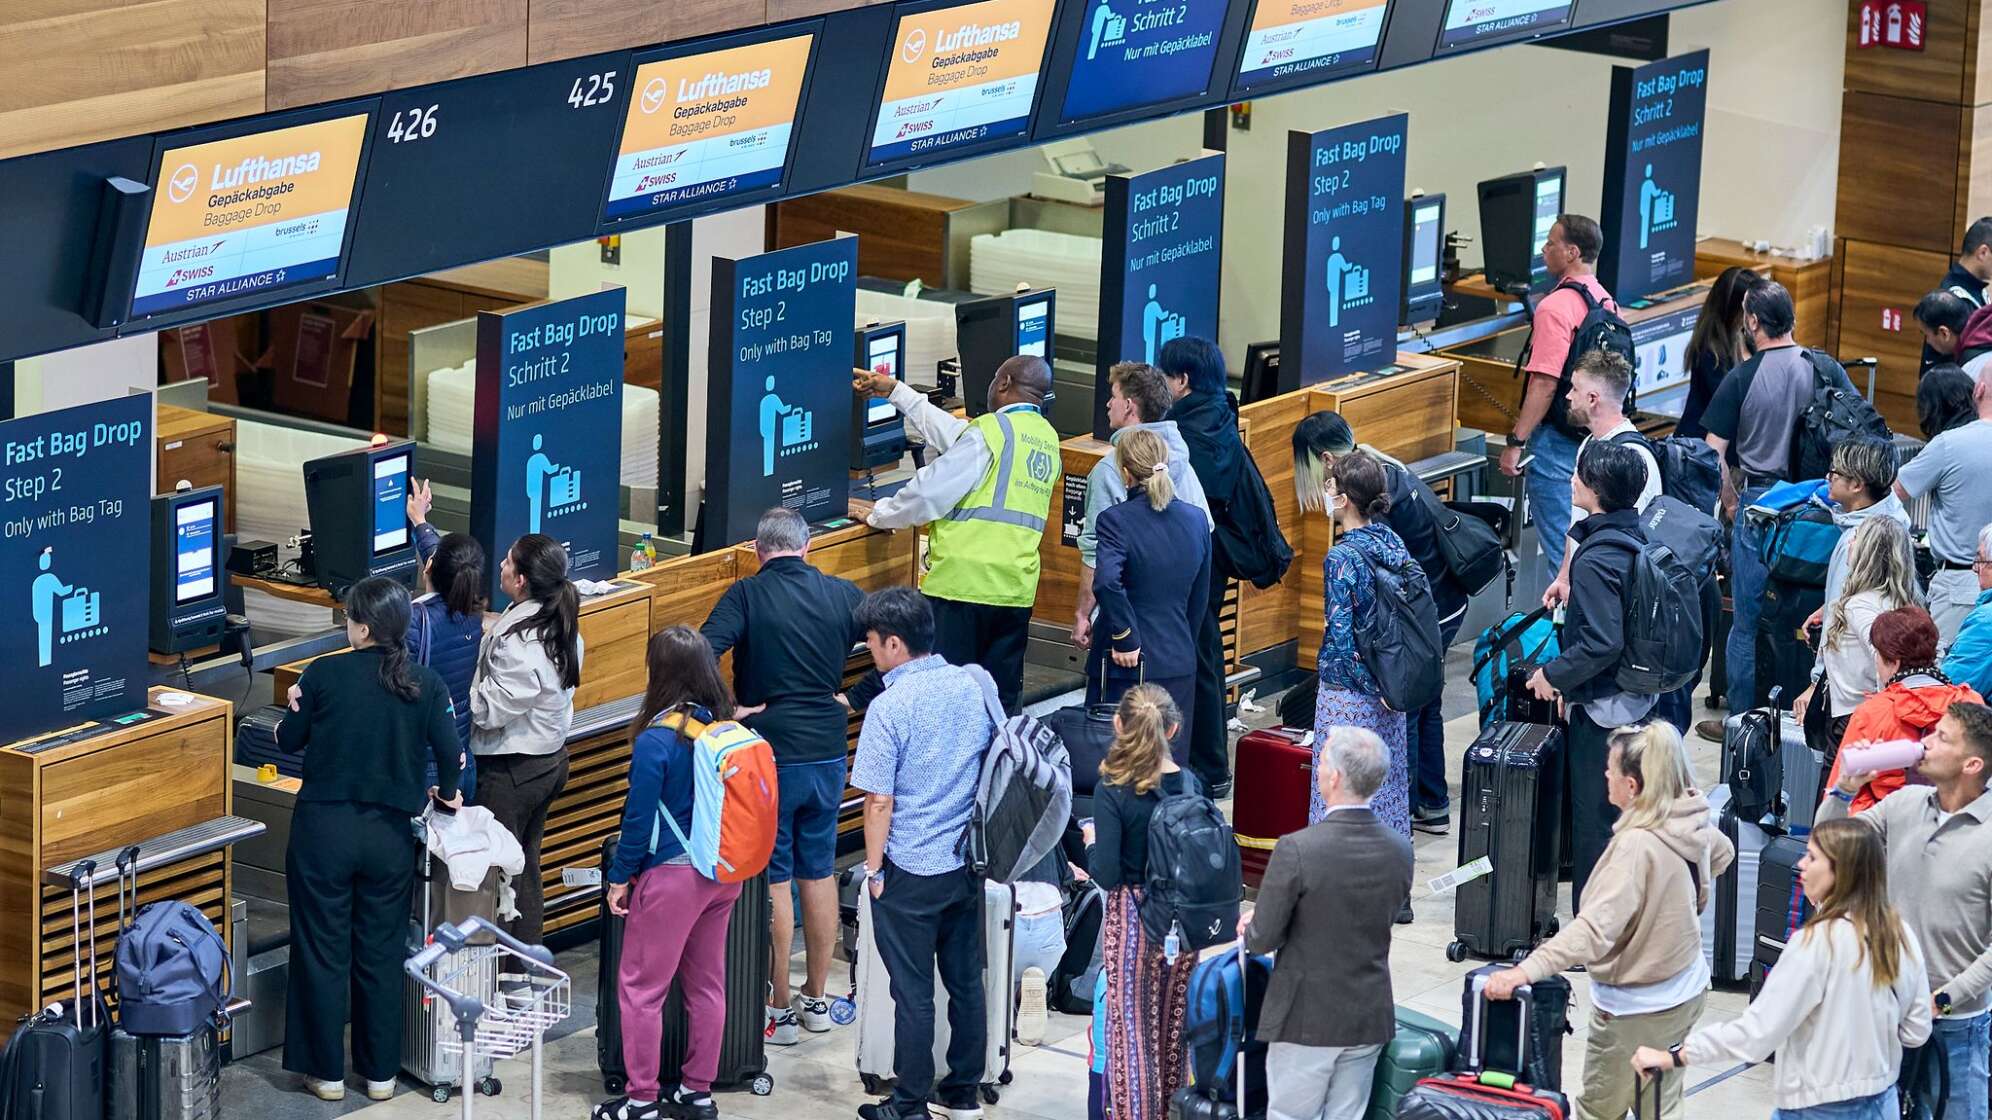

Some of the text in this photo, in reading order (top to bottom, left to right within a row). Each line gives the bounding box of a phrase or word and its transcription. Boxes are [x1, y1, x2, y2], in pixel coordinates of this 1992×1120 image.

[1131, 5, 1186, 32] Schritt 2
[1476, 14, 1529, 34] STAR ALLIANCE
[935, 20, 1020, 53] Lufthansa
[1124, 31, 1212, 61] Nur mit Gepäcklabel
[932, 47, 999, 69] Gepäckabgabe
[1272, 48, 1294, 60] SWISS
[1274, 56, 1331, 77] STAR ALLIANCE
[677, 68, 771, 103] Lufthansa
[928, 65, 988, 85] Baggage Drop
[1637, 67, 1704, 99] Fast Bag Drop
[567, 71, 616, 109] 425
[674, 96, 747, 119] Gepäckabgabe
[895, 102, 930, 117] Austrian
[1635, 99, 1673, 126] Schritt 2
[387, 104, 439, 143] 426
[669, 115, 736, 136] Baggage Drop
[908, 120, 933, 134] SWISS
[911, 128, 978, 151] STAR ALLIANCE
[1315, 134, 1400, 167] Fast Bag Drop
[1632, 138, 1644, 152] Nur
[211, 151, 320, 190] Lufthansa
[633, 153, 672, 170] Austrian
[650, 173, 676, 187] SWISS
[652, 180, 726, 205] STAR ALLIANCE
[1314, 170, 1350, 196] Step 2
[208, 182, 294, 208] Gepäckabgabe
[1134, 176, 1217, 213] Fast Bag Drop
[204, 202, 281, 227] Baggage Drop
[1313, 195, 1386, 225] Only with Bag Tag
[275, 223, 306, 237] brussels
[1132, 212, 1180, 242] Schritt 2
[162, 243, 208, 264] Austrian
[1130, 236, 1213, 272] Nur mit Gepäcklabel
[182, 265, 213, 282] SWISS
[186, 273, 272, 301] STAR ALLIANCE
[743, 260, 848, 298] Fast Bag Drop
[741, 301, 785, 330] Step 2
[510, 312, 617, 355] Fast Bag Drop
[740, 329, 832, 362] Only with Bag Tag
[509, 352, 570, 388] Schritt 2
[507, 379, 613, 421] Nur mit Gepäcklabel
[6, 420, 141, 466] Fast Bag Drop
[6, 468, 62, 502] Step 2
[5, 498, 122, 540] Only with Bag Tag
